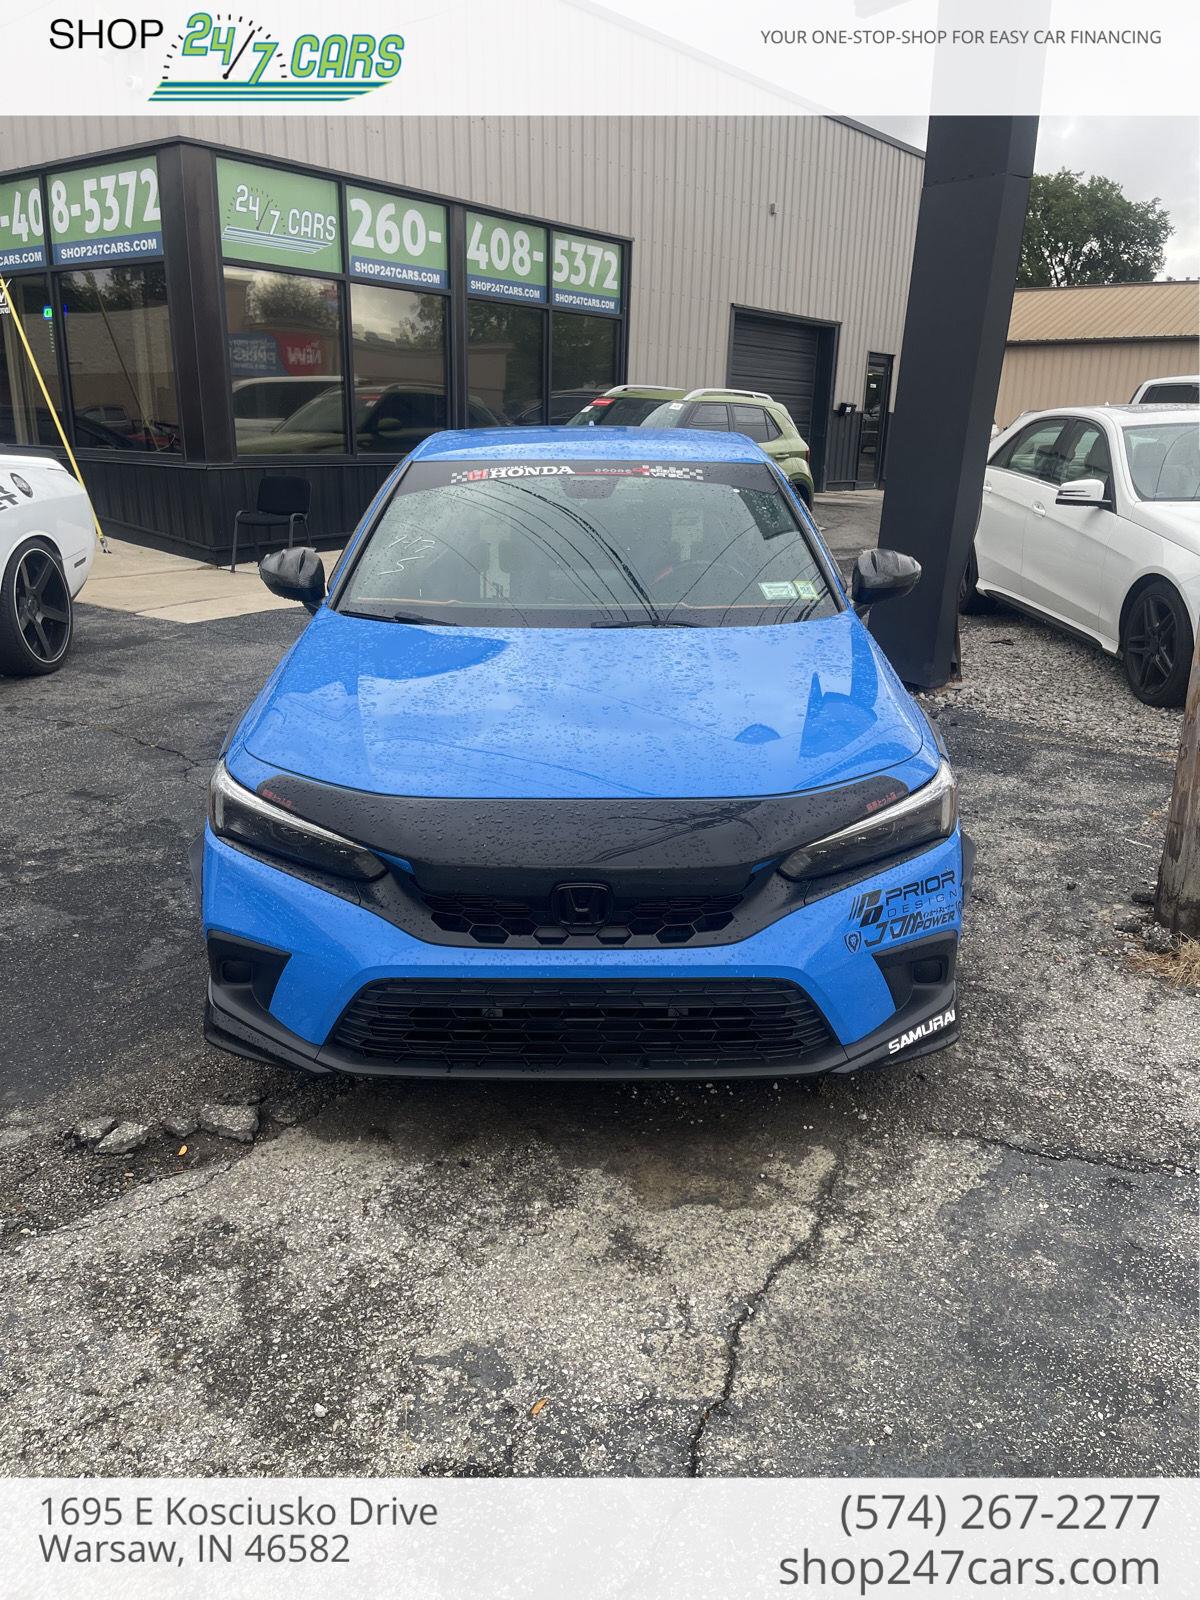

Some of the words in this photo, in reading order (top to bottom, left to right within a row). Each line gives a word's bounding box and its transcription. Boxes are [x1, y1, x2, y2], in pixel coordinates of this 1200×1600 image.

[288, 208, 337, 241] CARS
[61, 238, 157, 260] SHOP247CARS.COM
[350, 198, 442, 257] 260-
[466, 221, 544, 277] 408-
[552, 238, 619, 291] 5372
[354, 261, 441, 285] SHOP247CARS.COM
[470, 280, 541, 299] SHOP247CARS.COM
[555, 293, 615, 310] SHOP247CARS.COM
[489, 466, 576, 478] HONDA
[885, 869, 956, 907] PRIOR
[887, 888, 958, 918] DESIGN
[888, 1009, 956, 1055] SAMURAI
